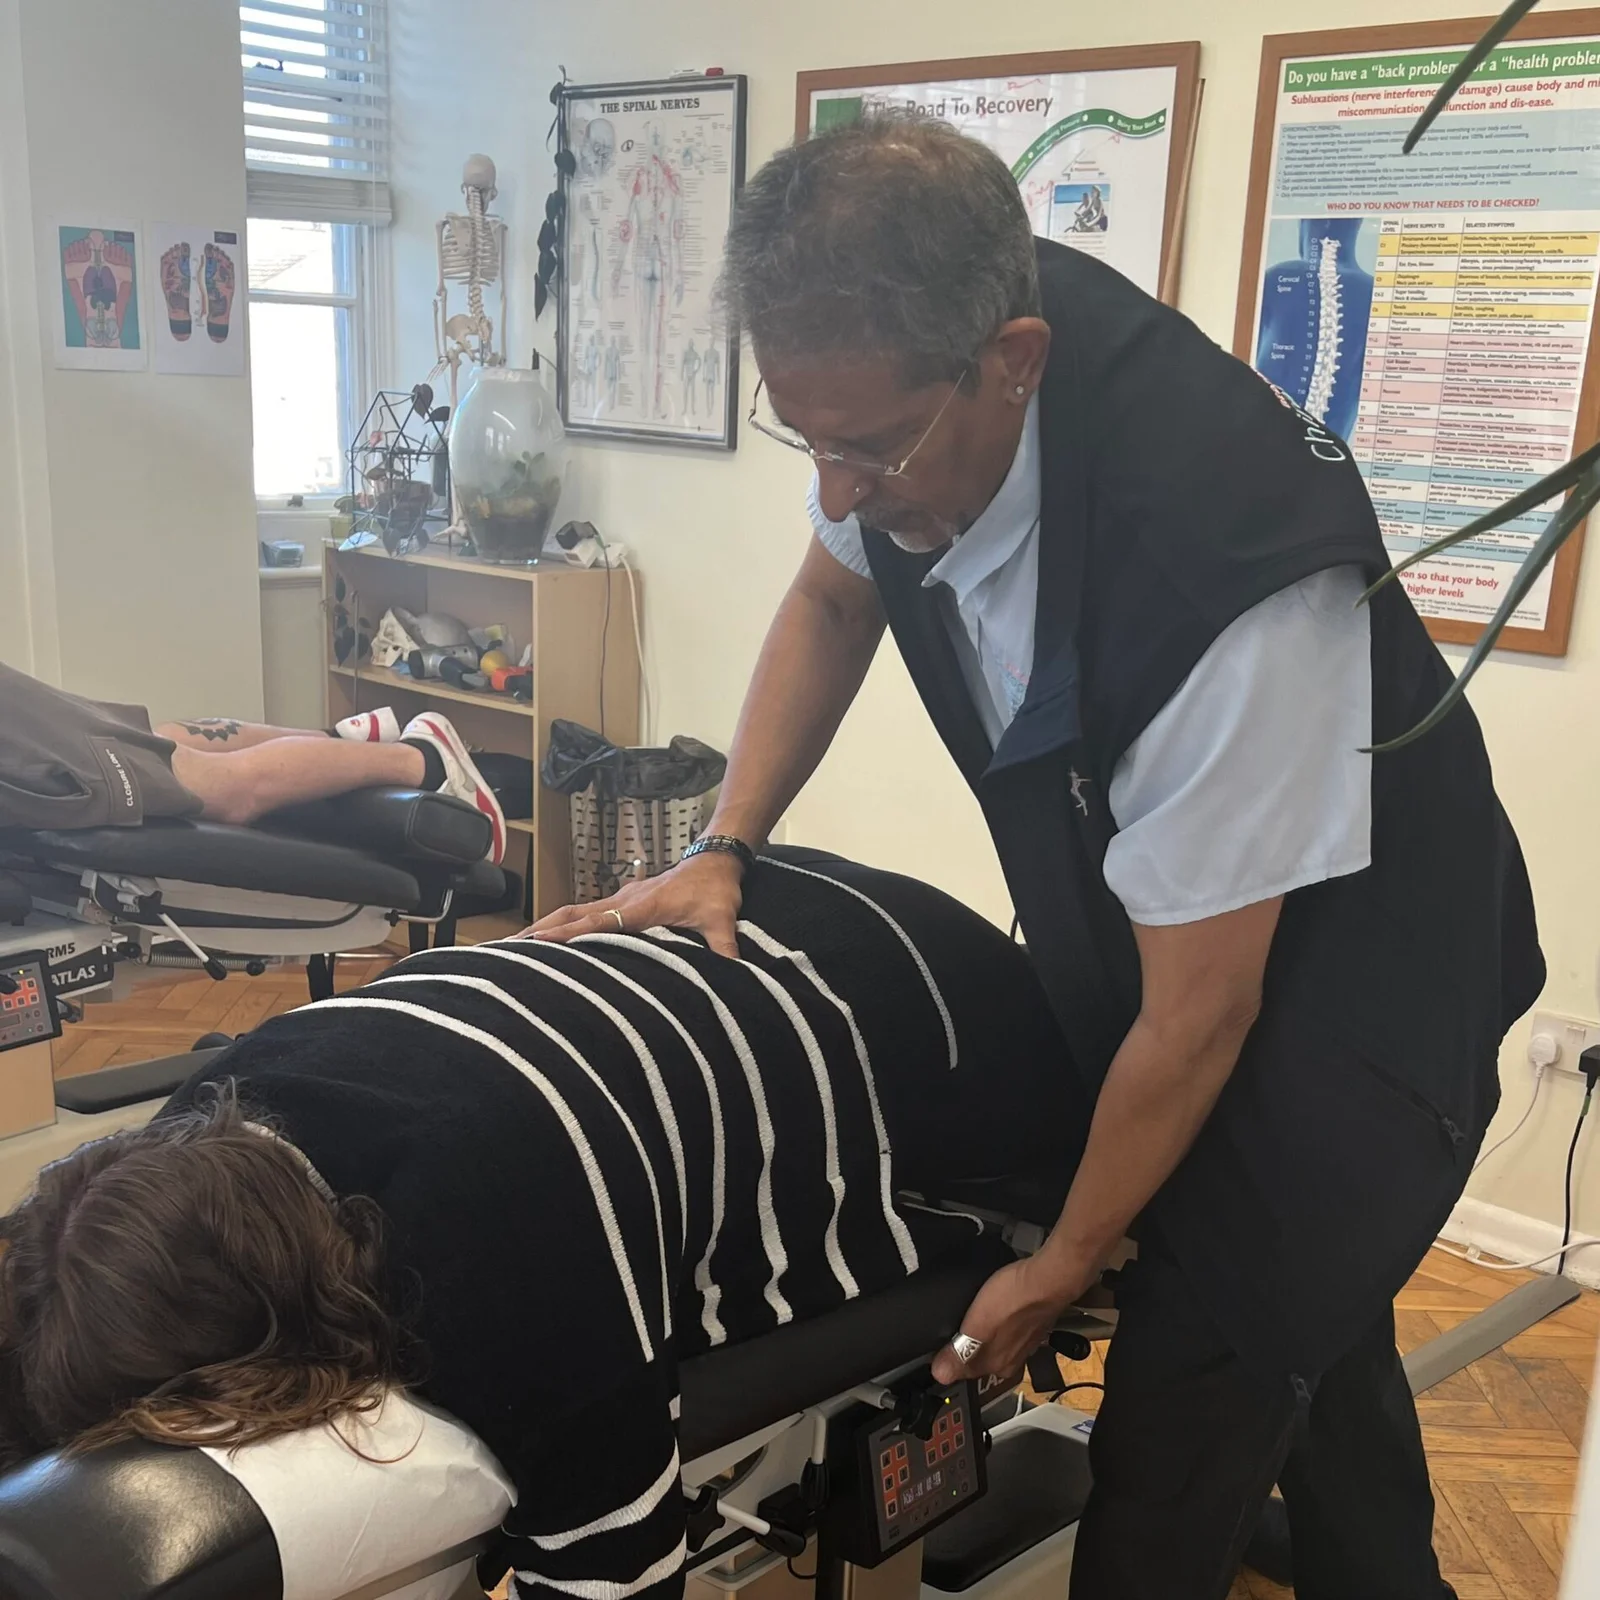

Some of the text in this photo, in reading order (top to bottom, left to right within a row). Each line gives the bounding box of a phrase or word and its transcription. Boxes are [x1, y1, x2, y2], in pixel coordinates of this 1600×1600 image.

[1288, 70, 1304, 84] Do
[1306, 72, 1327, 87] you
[1331, 68, 1357, 81] have
[1360, 70, 1367, 80] a
[1489, 61, 1497, 71] a
[1291, 77, 1600, 105] Subluxations (nerve interferenc damage) cause body and mi
[600, 98, 700, 114] THE SPINAL NERVES
[906, 98, 946, 117] Road
[951, 97, 970, 115] To
[975, 96, 1054, 117] Recovery
[1442, 99, 1486, 112] function
[1489, 98, 1508, 109] and
[1510, 97, 1554, 109] dis-ease.
[1348, 202, 1362, 210] DO
[1363, 202, 1381, 210] YOU
[1383, 201, 1410, 209] KNOW
[1412, 200, 1434, 208] THAT
[1436, 200, 1465, 208] NEEDS
[1467, 200, 1479, 208] TO
[1481, 200, 1492, 208] BE
[1278, 275, 1300, 283] Cervical
[1430, 573, 1449, 582] that
[1451, 575, 1472, 586] your
[1475, 575, 1499, 590] body
[1407, 583, 1464, 598] higher levels
[117, 769, 134, 807] CLOSURE
[51, 965, 96, 986] ATLAS
